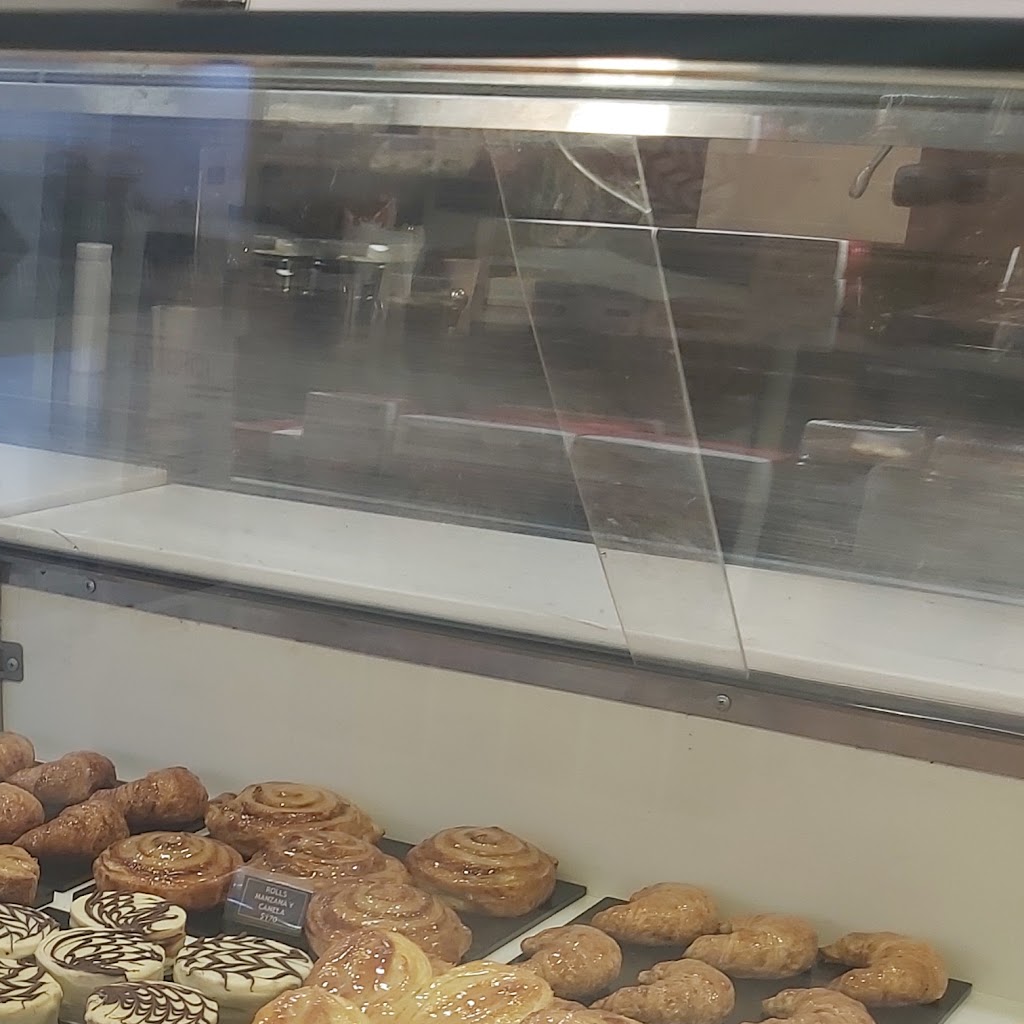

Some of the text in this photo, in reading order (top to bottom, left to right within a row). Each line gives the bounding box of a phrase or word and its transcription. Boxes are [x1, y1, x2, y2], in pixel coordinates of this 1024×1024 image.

[265, 886, 288, 898] ROLLS
[254, 893, 287, 907] MANZANA
[258, 903, 285, 916] CANELA
